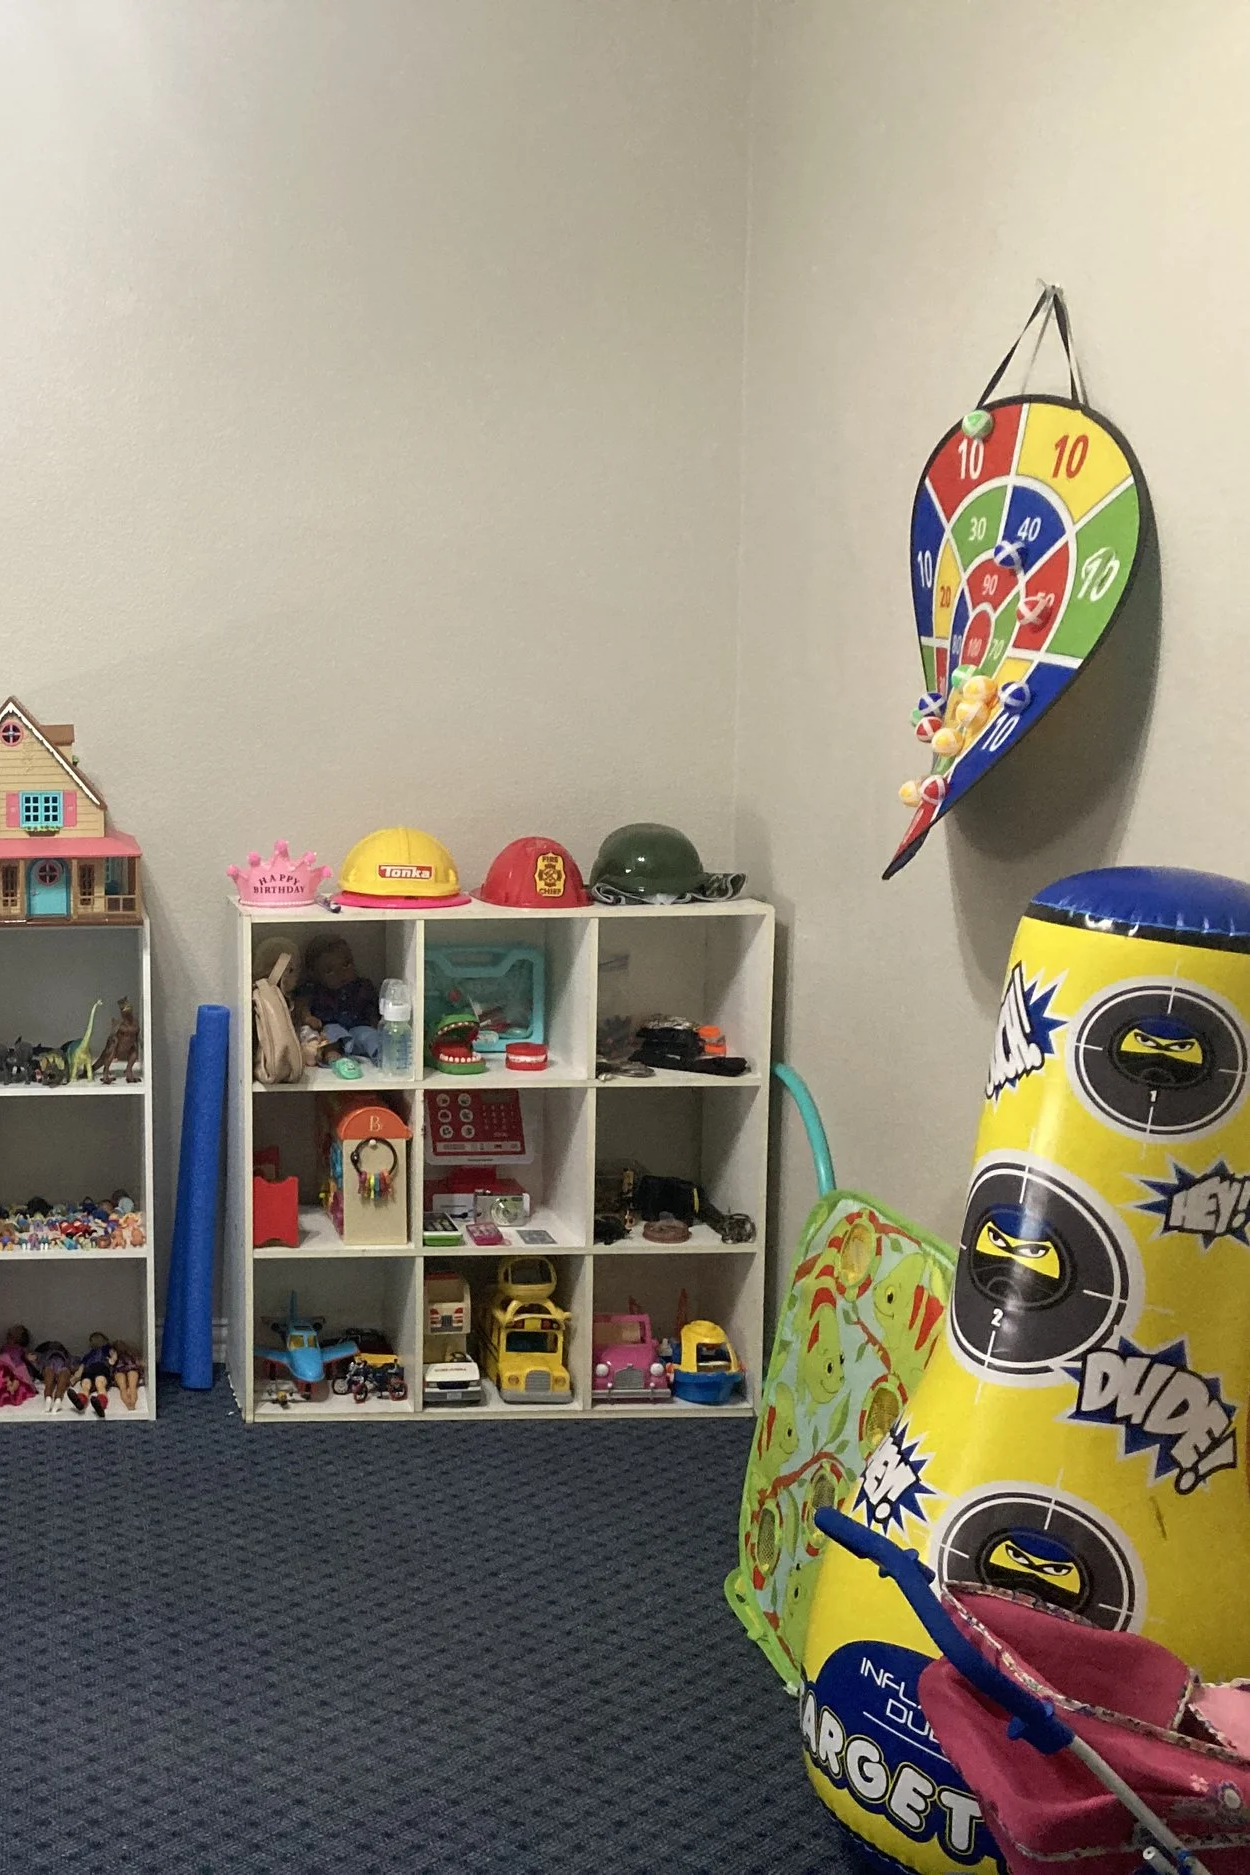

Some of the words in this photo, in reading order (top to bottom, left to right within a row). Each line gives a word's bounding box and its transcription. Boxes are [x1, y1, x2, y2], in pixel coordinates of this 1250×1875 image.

[958, 438, 985, 480] 10
[1052, 434, 1089, 479] 10
[969, 516, 987, 541] 30
[1017, 516, 1041, 542] 40
[917, 549, 933, 588] 10
[939, 585, 951, 609] 20
[982, 574, 998, 596] 90
[981, 712, 1021, 752] 10
[542, 855, 559, 863] FIRE
[259, 873, 301, 886] HAPPY
[380, 865, 431, 880] Tonka
[253, 885, 305, 895] BIRTHDAY
[1150, 1090, 1158, 1103] 1
[1168, 1174, 1250, 1234] HEY!
[991, 1308, 1004, 1327] 2
[1079, 1349, 1237, 1493] DUDE!
[860, 1657, 922, 1710] INFL
[802, 1690, 984, 1853] ARGET
